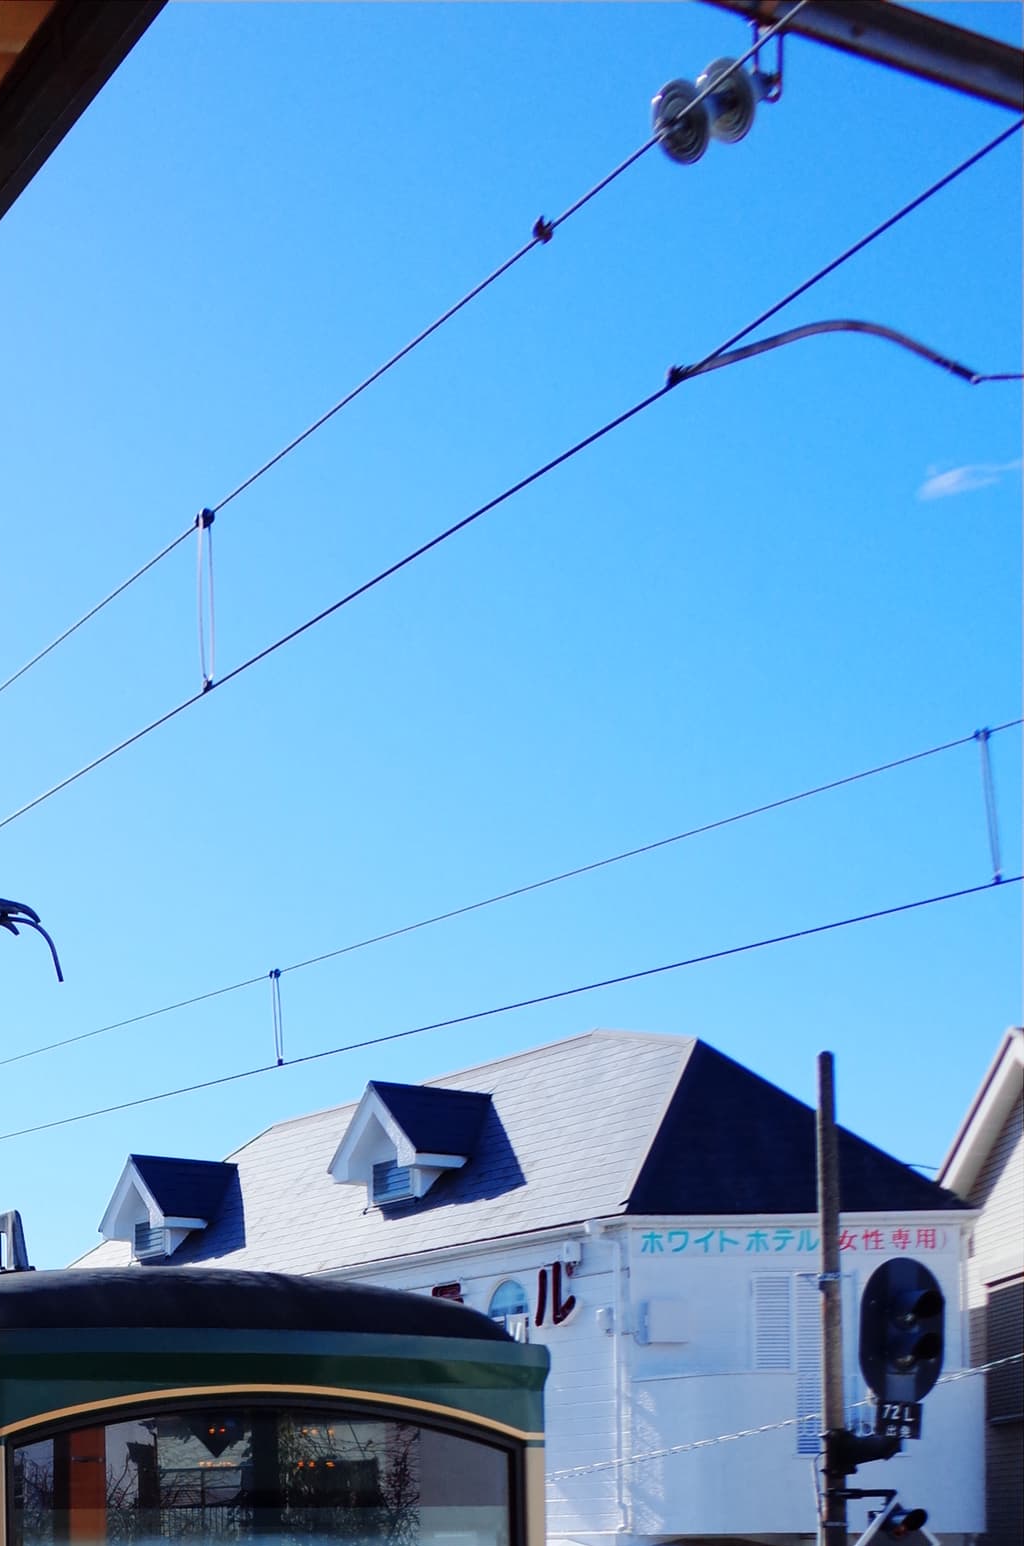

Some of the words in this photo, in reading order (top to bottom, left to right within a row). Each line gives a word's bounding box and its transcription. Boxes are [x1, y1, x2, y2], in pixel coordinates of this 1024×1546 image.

[641, 1229, 820, 1253] ホワイトホテル
